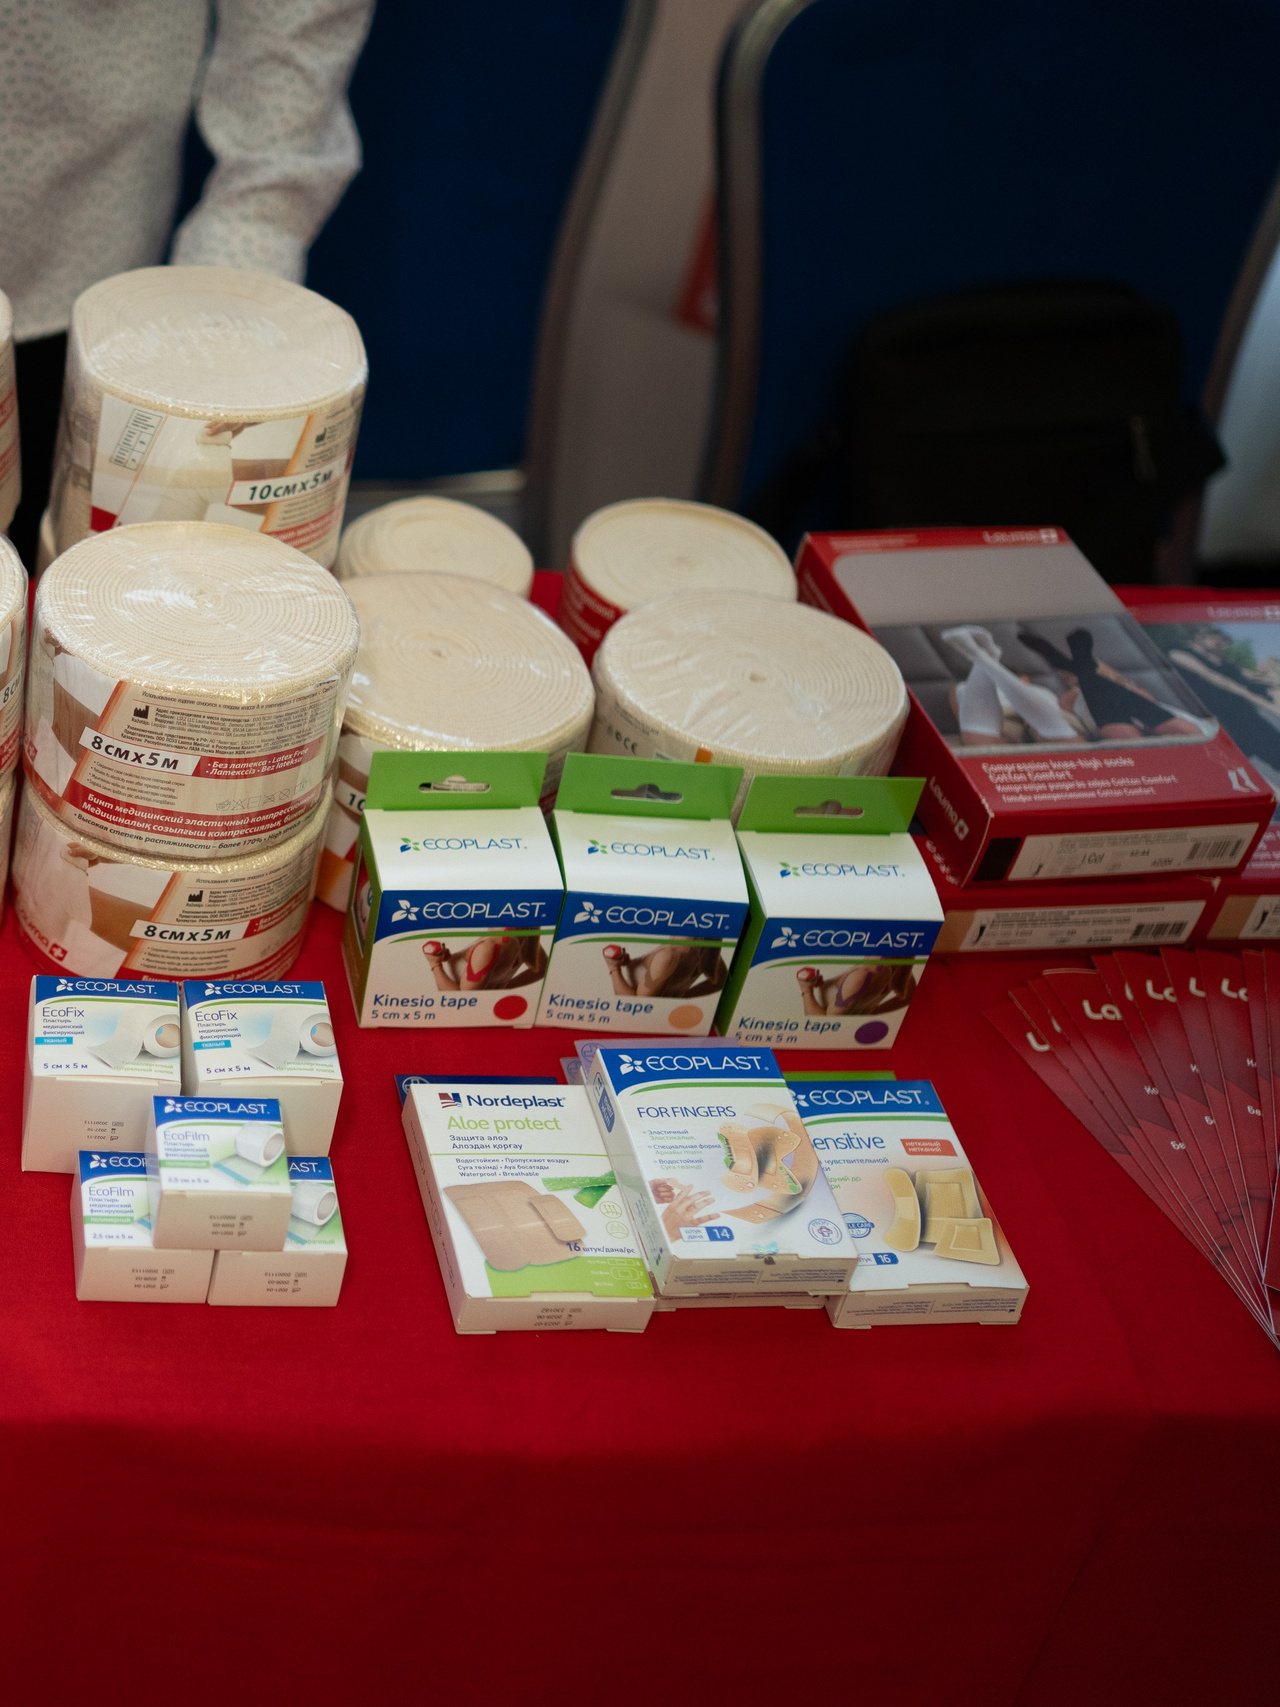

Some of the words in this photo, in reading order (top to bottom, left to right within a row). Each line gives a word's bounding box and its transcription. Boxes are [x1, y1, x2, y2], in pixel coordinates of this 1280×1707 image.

[272, 753, 293, 764] Latex
[293, 748, 309, 758] Free
[212, 761, 228, 769] Без
[229, 760, 267, 769] латекса
[261, 763, 275, 773] Bez
[276, 757, 303, 770] lateksa
[210, 767, 256, 776] Латекссіз
[87, 793, 114, 809] Бинт
[115, 805, 183, 823] медицинский
[185, 817, 249, 827] эластичный
[82, 802, 151, 830] Медициналық
[152, 825, 206, 837] созылғыш
[208, 821, 281, 837] компрессиялық
[77, 813, 108, 831] Высокая
[110, 828, 143, 840] степень
[144, 836, 211, 850] растяжимости
[218, 841, 241, 849] более
[242, 838, 263, 846] 170%
[423, 838, 522, 850] ECOPLAST
[611, 843, 711, 861] ECOPLAST
[801, 863, 899, 877] ECOPLAST
[422, 902, 546, 920] ECOPLAST
[605, 906, 730, 930] ECOPLAST
[803, 930, 924, 948] ECOPLAST
[75, 981, 155, 994] ECOPLAST
[223, 984, 301, 994] ECOPLAST
[373, 993, 435, 1008] Kinesio
[441, 994, 478, 1011] tape
[549, 994, 610, 1011] Kinesio
[617, 998, 653, 1016] tape
[42, 1007, 85, 1017] EcoFix
[195, 1010, 238, 1022] EcoFix
[372, 1010, 378, 1019] 5
[382, 1012, 400, 1020] cm
[414, 1010, 421, 1019] 5
[424, 1012, 435, 1020] m
[546, 1010, 553, 1019] 5
[556, 1012, 573, 1021] cm
[588, 1013, 595, 1022] 5
[599, 1015, 610, 1023] m
[738, 1016, 799, 1031] Kinesio
[804, 1019, 841, 1033] tape
[745, 1033, 762, 1042] cm
[776, 1034, 783, 1043] 5
[786, 1035, 797, 1043] m
[646, 1056, 761, 1071] ECOPLAST
[467, 1095, 564, 1109] Nordeplast
[809, 1090, 922, 1105] ECOPLAST
[184, 1103, 267, 1114] ECOPLAST
[637, 1107, 670, 1118] FOR
[673, 1106, 736, 1118] FINGERS
[447, 1116, 489, 1131] Aloe
[494, 1117, 562, 1133] protect
[163, 1131, 210, 1142] EcoFilm
[813, 1133, 885, 1150] ensitive
[824, 1157, 889, 1165] чувствительной
[88, 1186, 134, 1196] EcoFilm
[713, 1229, 731, 1239] 14
[566, 1242, 581, 1252] 16
[878, 1254, 891, 1264] 16
